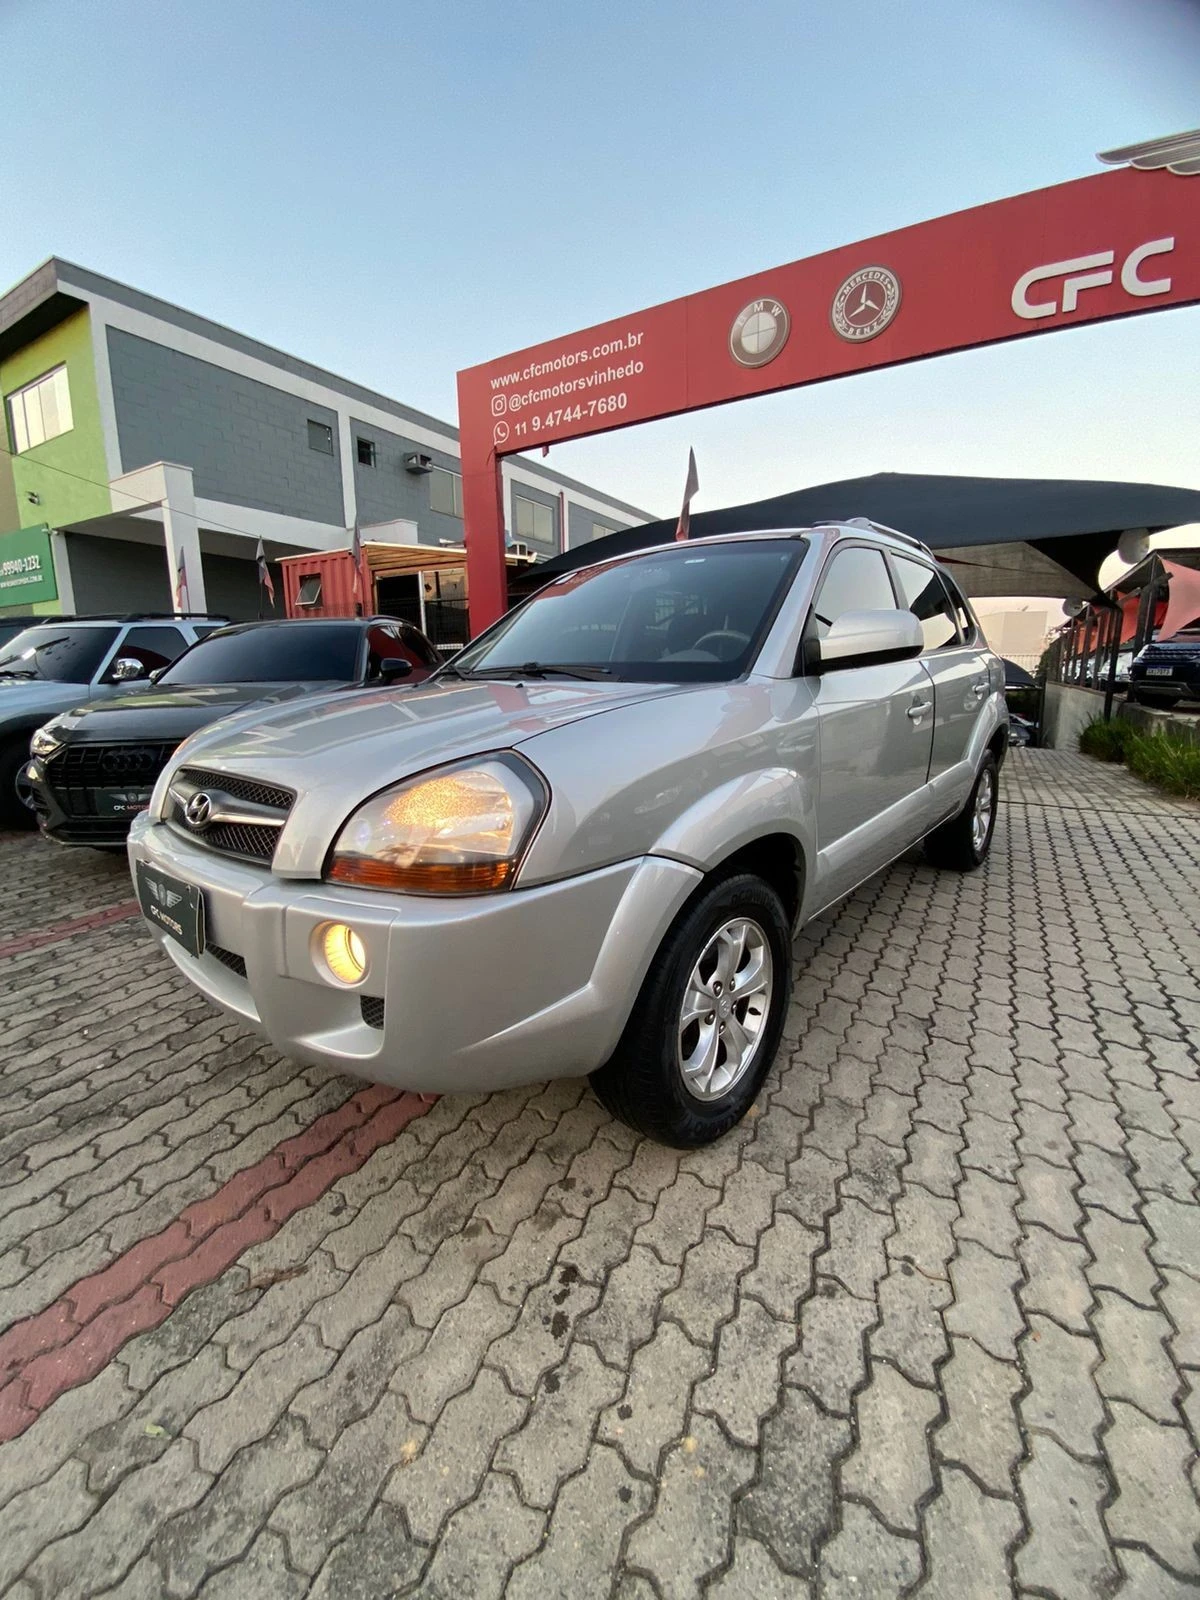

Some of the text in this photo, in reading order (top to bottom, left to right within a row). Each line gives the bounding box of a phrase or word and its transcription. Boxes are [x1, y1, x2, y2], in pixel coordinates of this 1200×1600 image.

[843, 271, 890, 296] MERCEDES
[1011, 236, 1175, 319] CFC
[738, 301, 782, 326] BMW
[848, 321, 880, 336] BENZ
[490, 331, 644, 389] www.cfcmotors.com.br
[508, 360, 644, 412] @cfcmotorsvinhedo
[514, 392, 628, 436] 11 9.4744-7680
